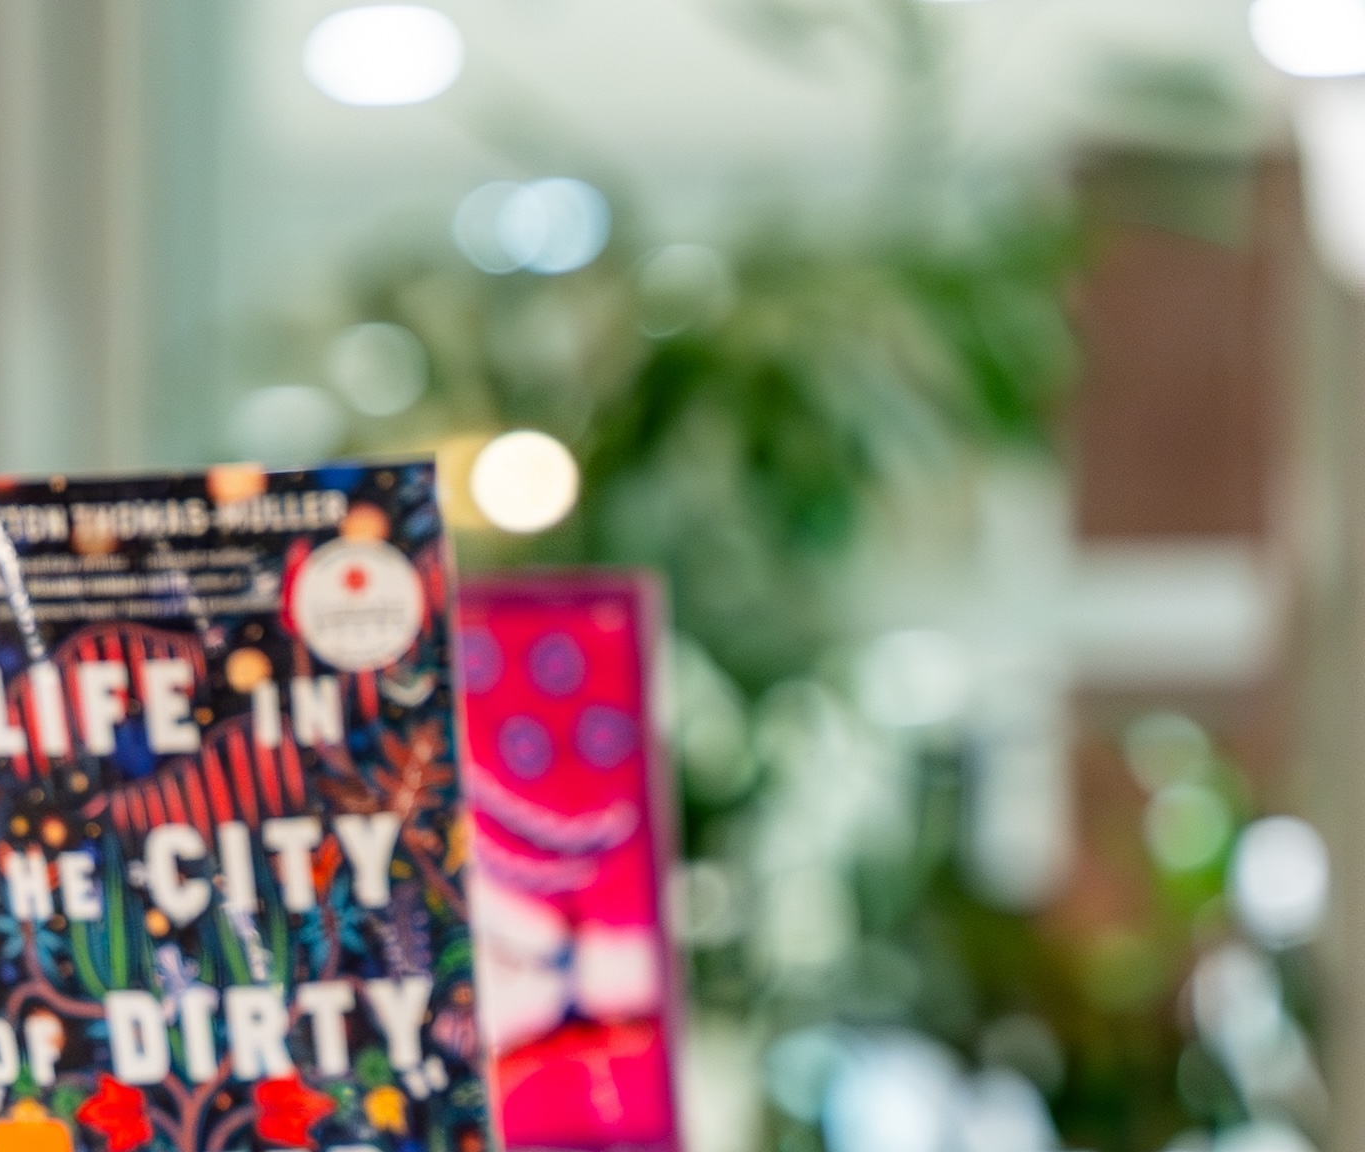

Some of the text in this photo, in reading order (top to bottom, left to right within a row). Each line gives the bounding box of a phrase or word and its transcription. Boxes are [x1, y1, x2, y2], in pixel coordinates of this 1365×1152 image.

[252, 675, 345, 748] IN
[144, 811, 404, 925] CITY
[104, 976, 434, 1086] DIRTY
